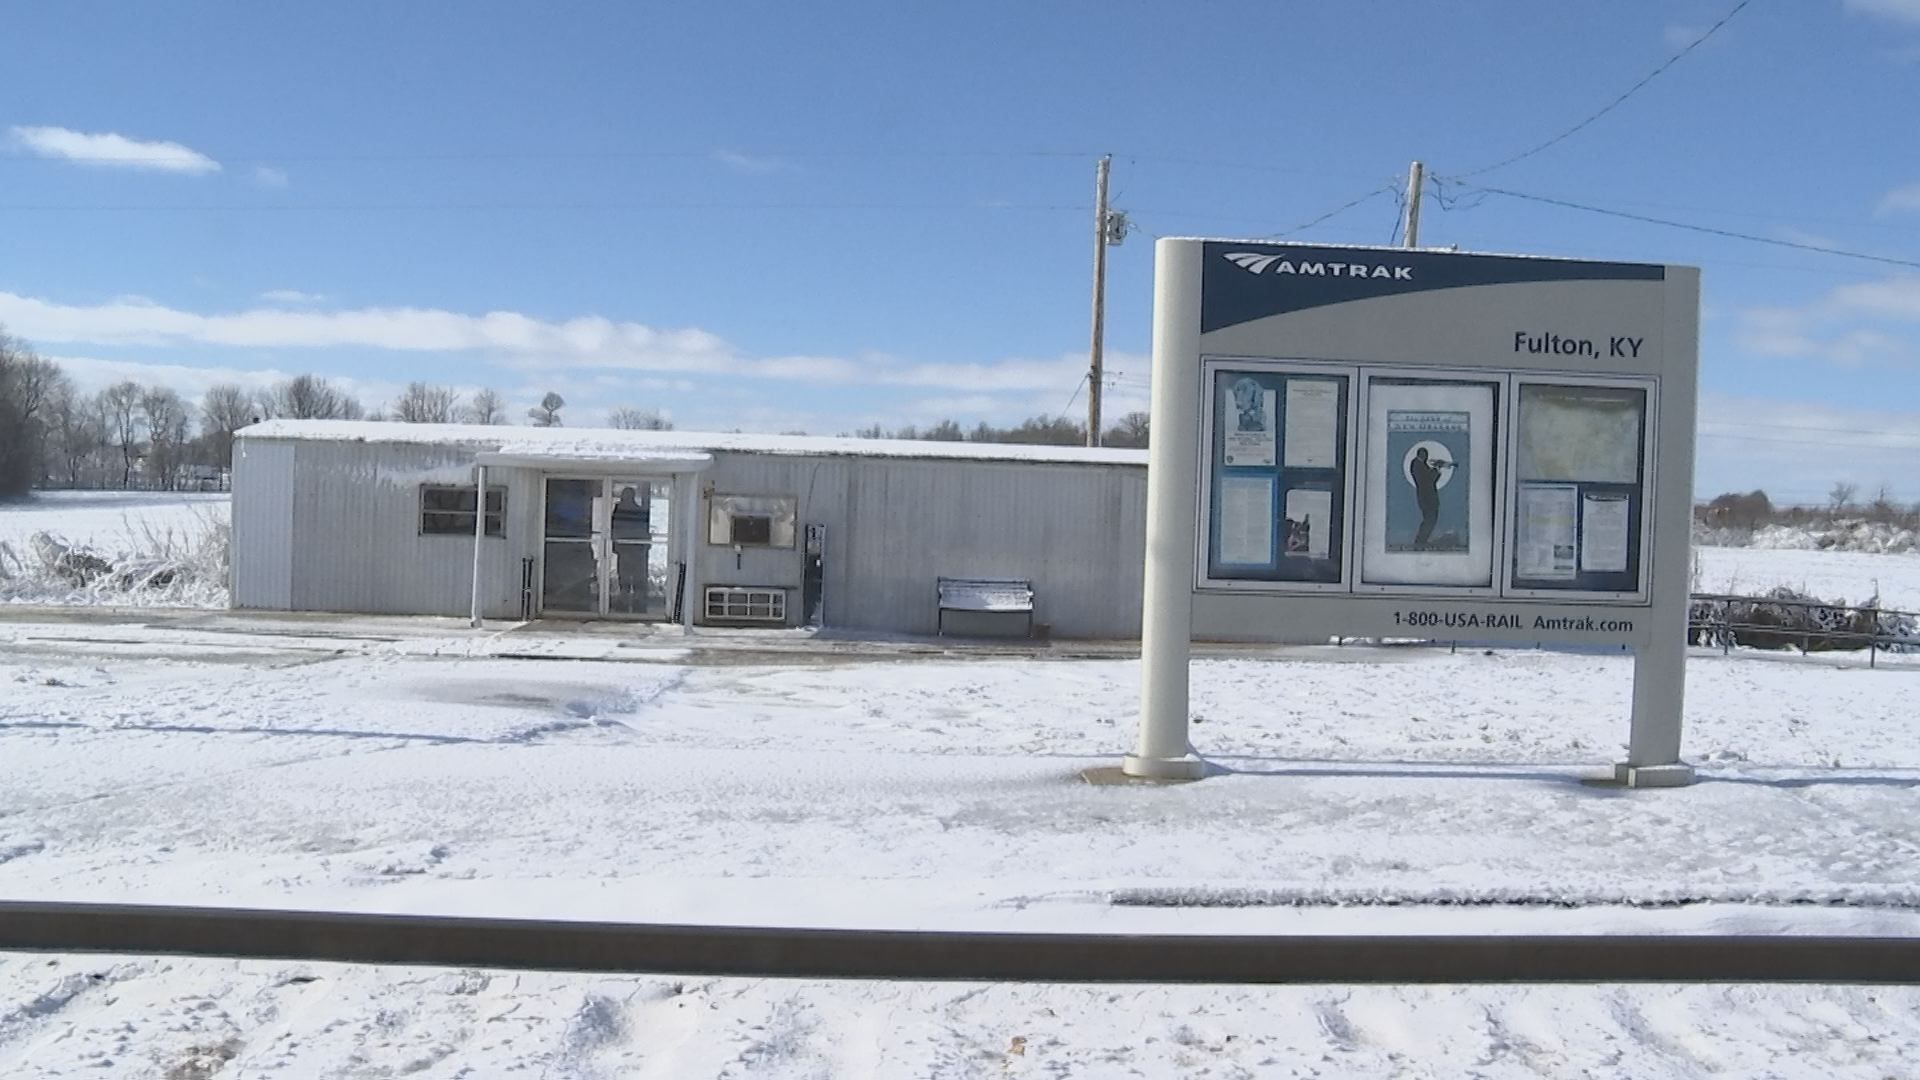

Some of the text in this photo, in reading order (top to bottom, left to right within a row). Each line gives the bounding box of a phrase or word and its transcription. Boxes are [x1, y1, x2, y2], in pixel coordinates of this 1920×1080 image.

[1276, 261, 1413, 280] AMTRAK
[1514, 331, 1643, 359] Fulton, KY
[1393, 611, 1633, 632] 1-800-USA-RAIL Amtrak.com
